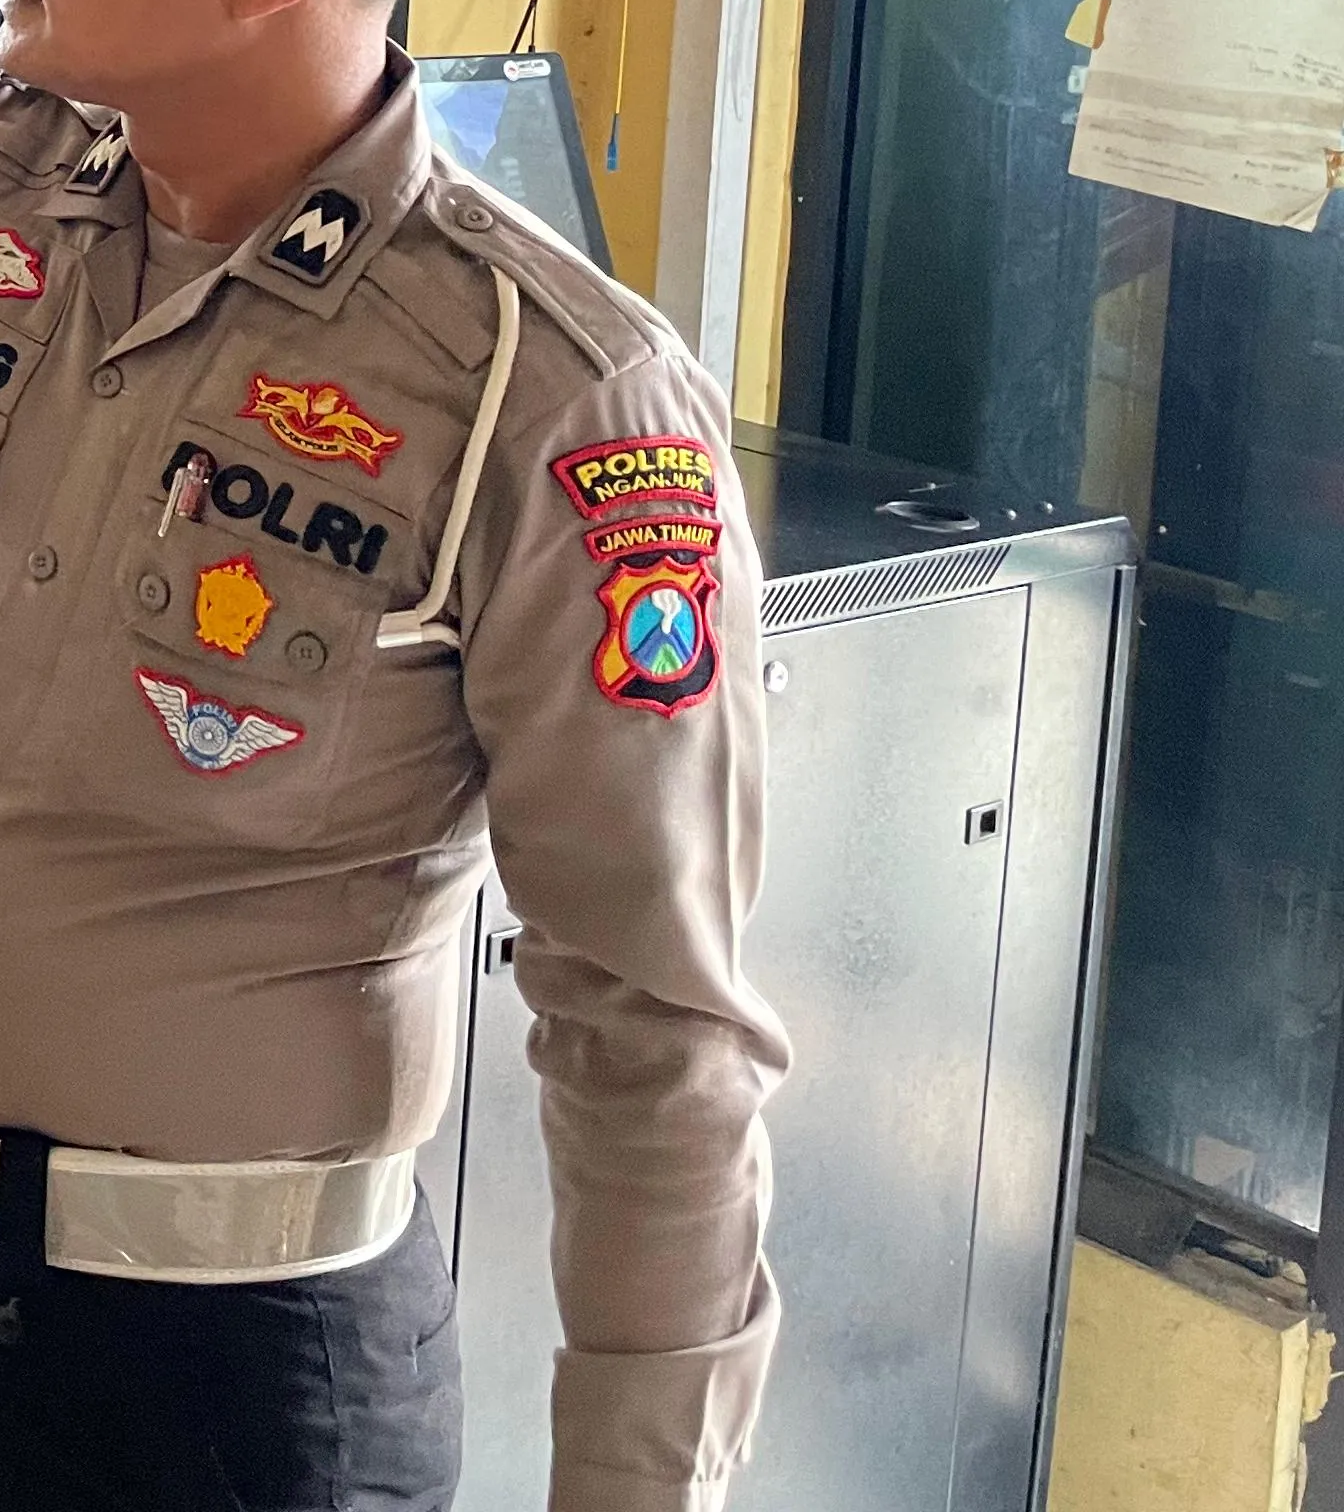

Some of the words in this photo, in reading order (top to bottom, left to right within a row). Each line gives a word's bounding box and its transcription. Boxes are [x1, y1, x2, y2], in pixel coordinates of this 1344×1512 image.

[575, 447, 713, 489] POLRES
[596, 472, 706, 502] NGANJUK
[162, 441, 389, 575] POLRI
[600, 526, 658, 553] JAWA
[658, 524, 714, 547] TIMUR
